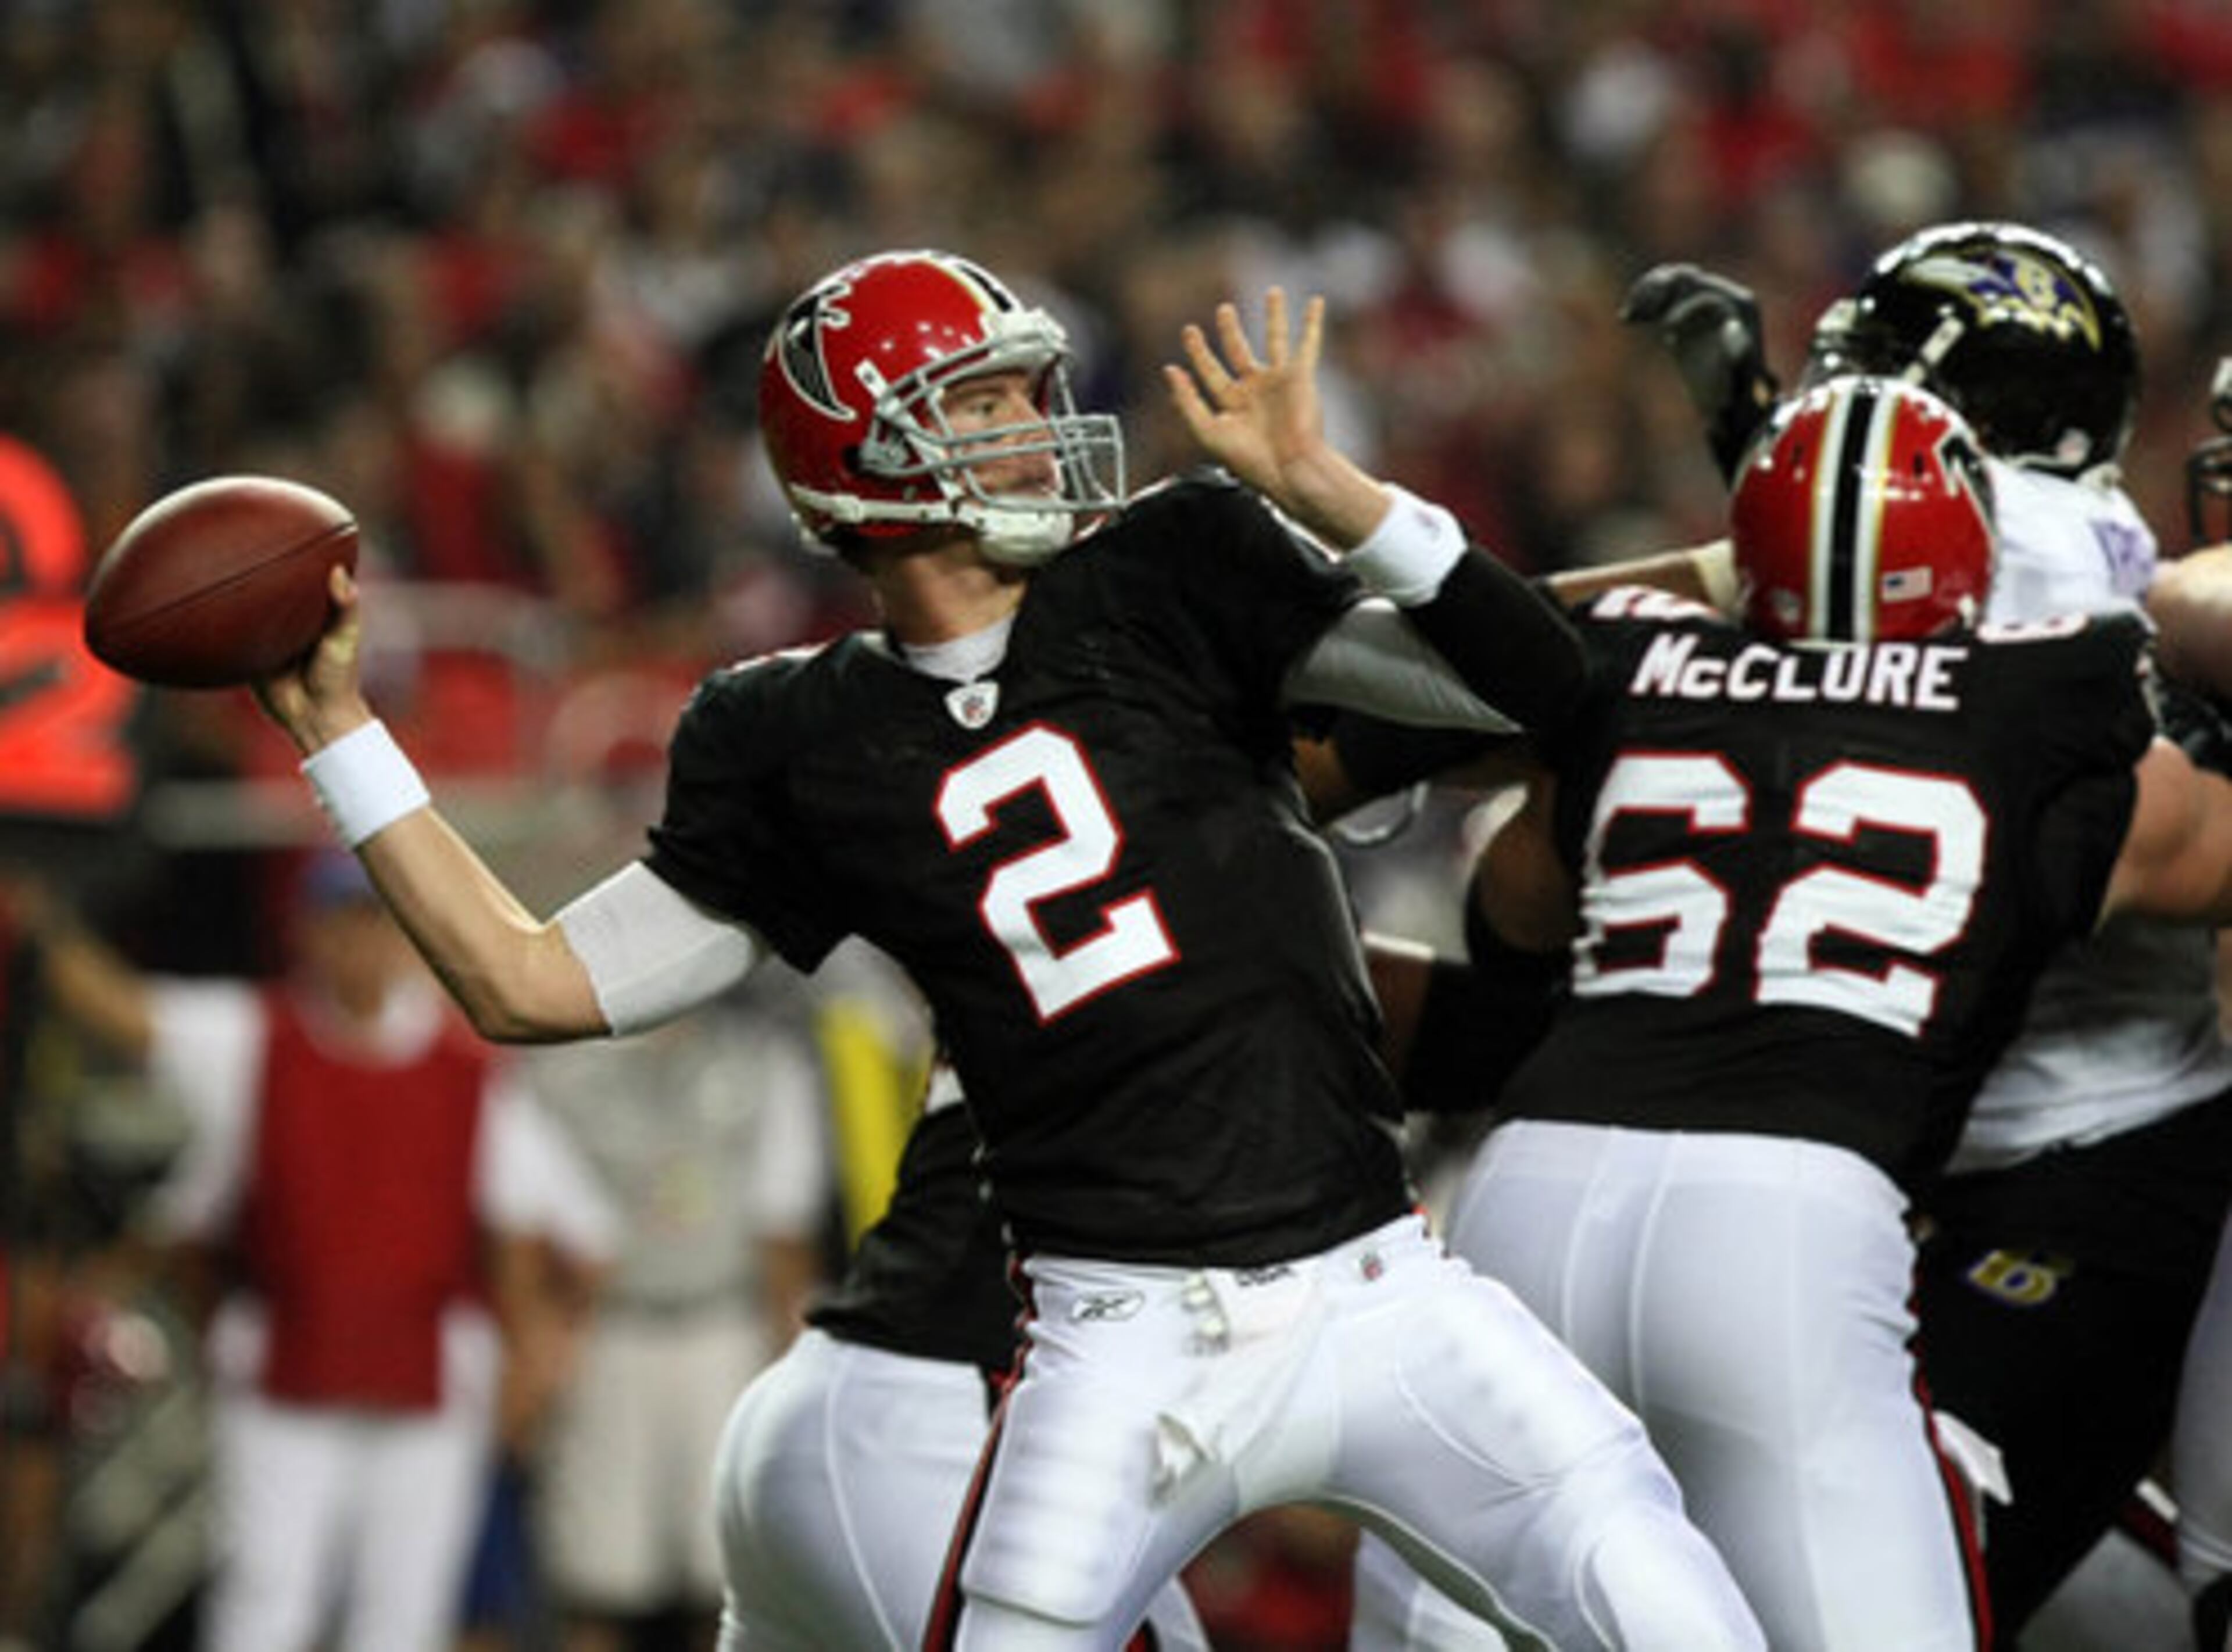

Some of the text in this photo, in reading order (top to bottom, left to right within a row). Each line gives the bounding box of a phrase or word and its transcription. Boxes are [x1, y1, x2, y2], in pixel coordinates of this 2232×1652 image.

[1629, 632, 1970, 712] McCLURE
[933, 718, 1182, 1029] 2
[1571, 750, 1988, 1038] 62
